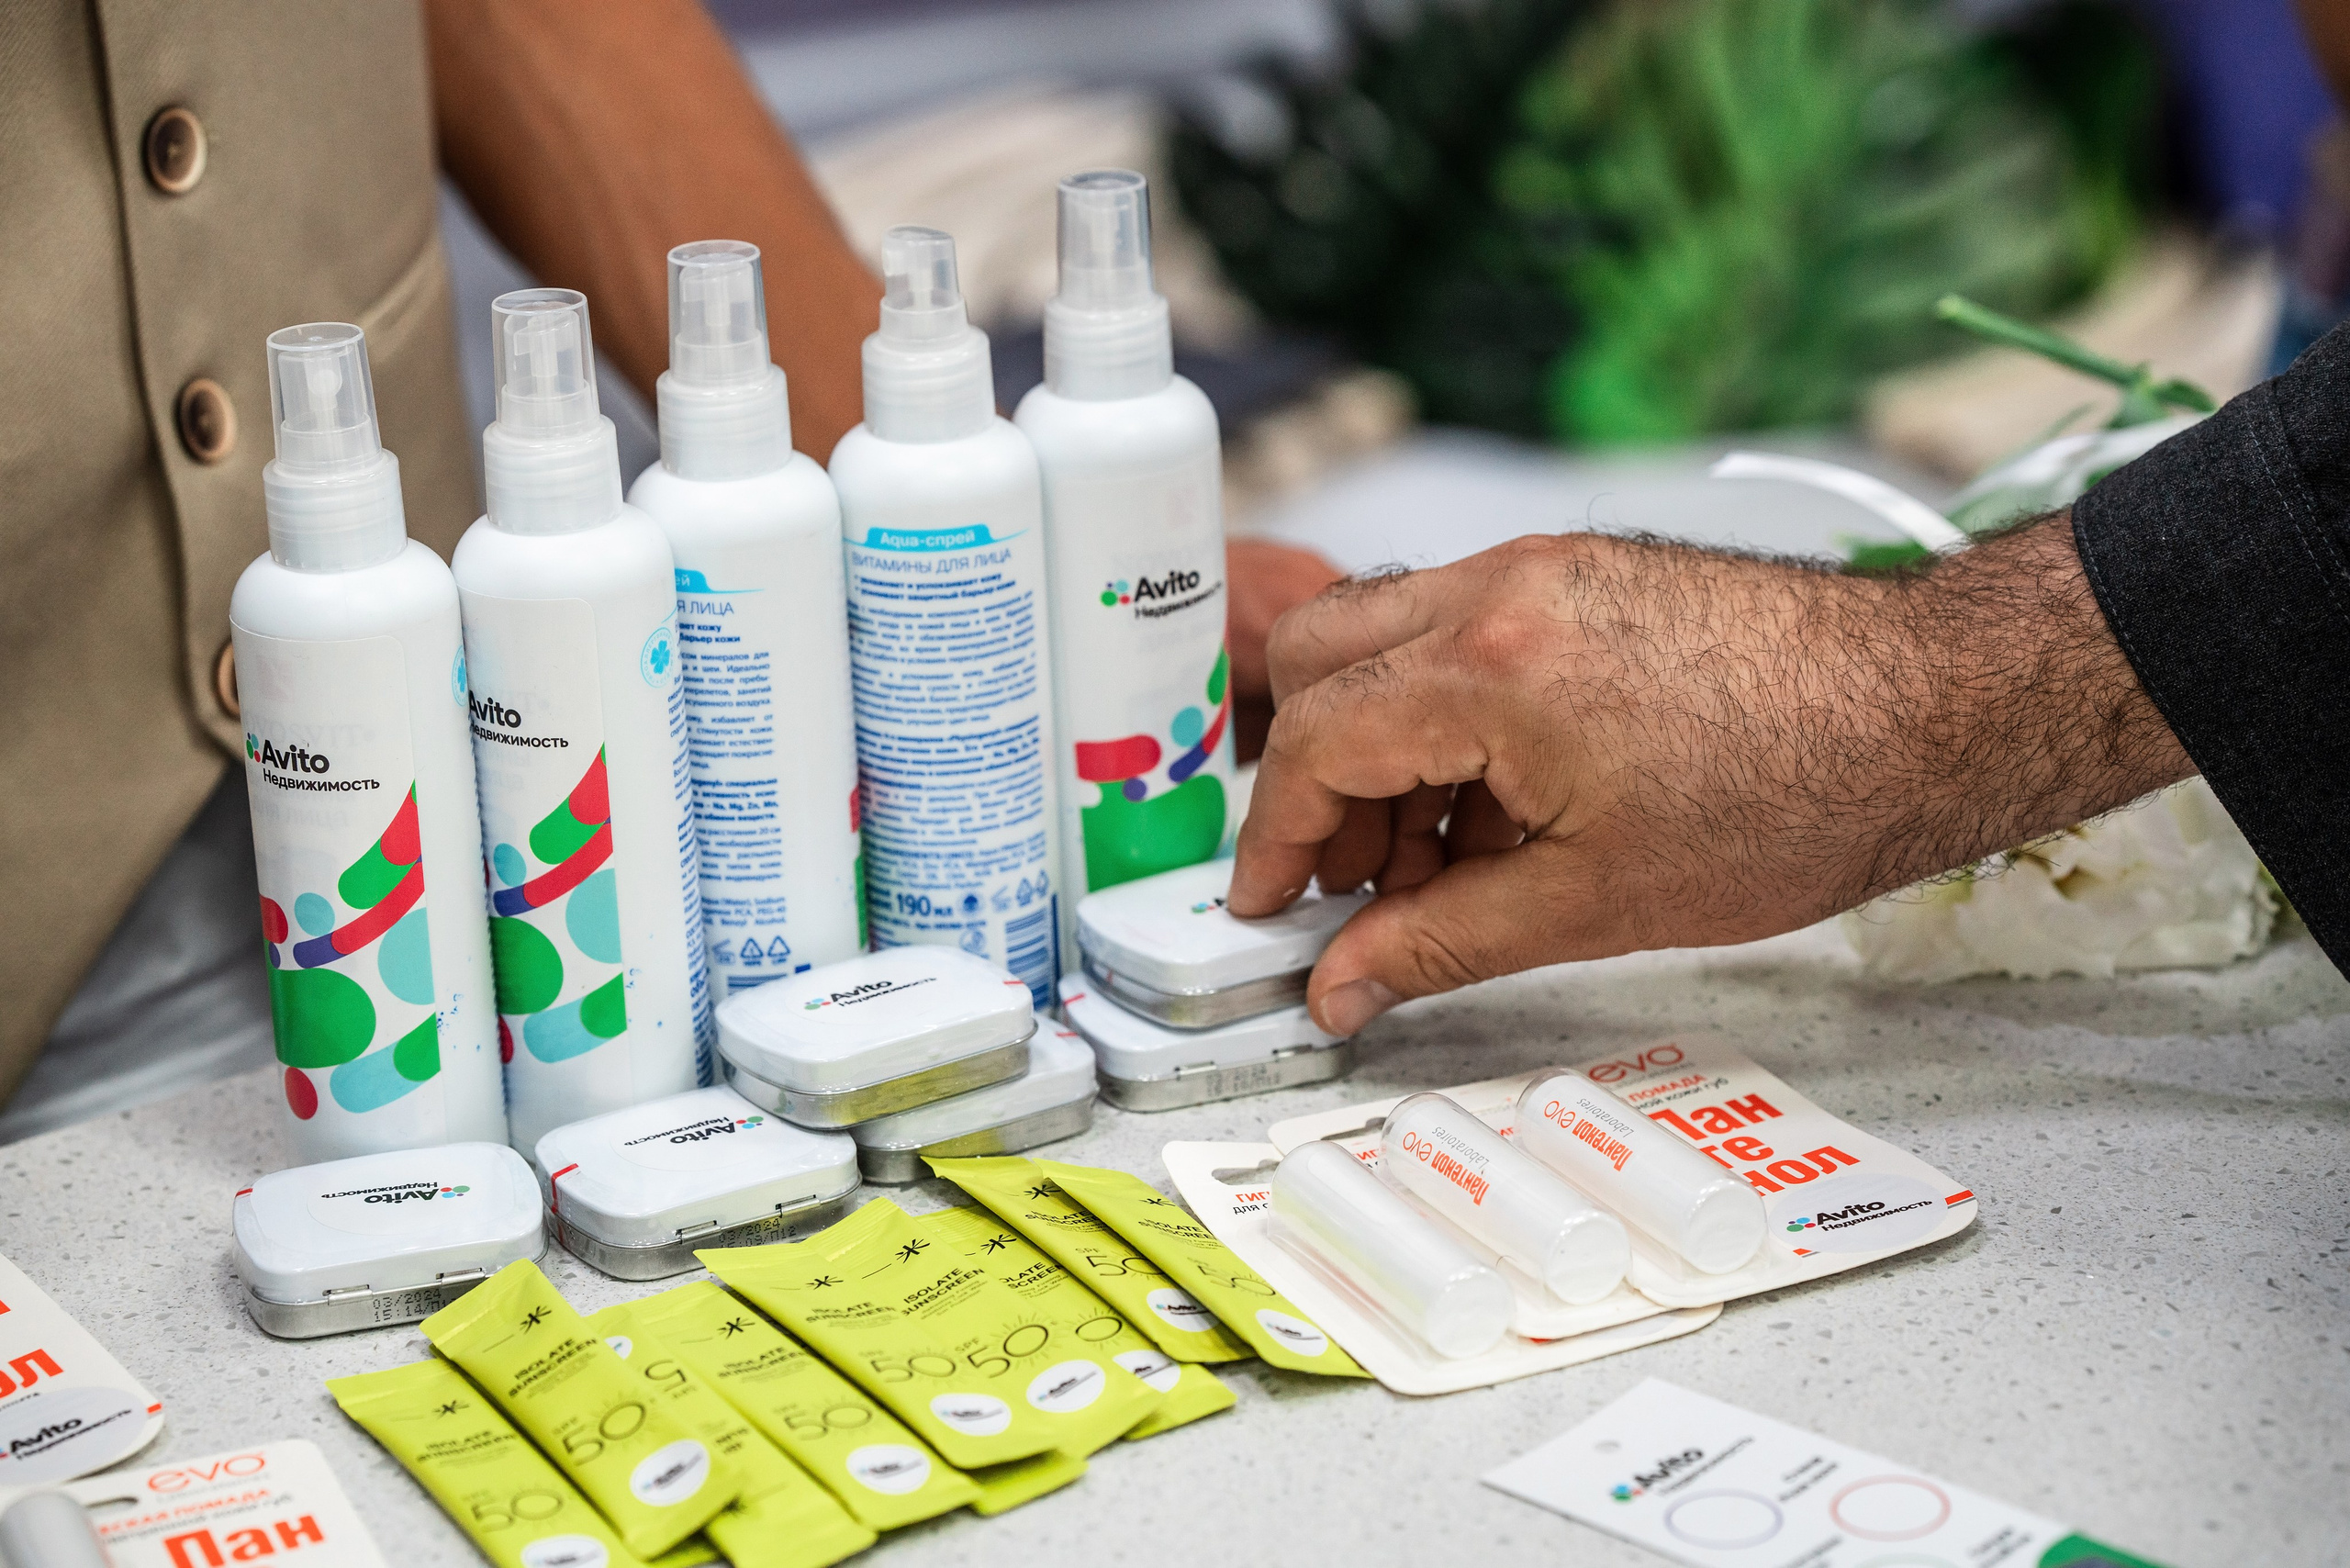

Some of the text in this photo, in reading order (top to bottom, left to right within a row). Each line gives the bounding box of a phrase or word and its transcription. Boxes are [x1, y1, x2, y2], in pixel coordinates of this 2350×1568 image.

[880, 530, 976, 549] Aqua-спрей
[852, 548, 1012, 574] ВИТАМИНЫ ДЛЯ ЛИЦА
[1135, 571, 1200, 602] Avito
[689, 601, 734, 617] ЛИЦА
[697, 623, 722, 633] кожу
[469, 690, 522, 728] Avito
[471, 723, 570, 748] едвижимость
[262, 739, 330, 774] Avito
[263, 767, 380, 792] Недвижимость
[897, 894, 932, 916] 190
[831, 980, 893, 1002] Avito
[1588, 1043, 1685, 1083] evo
[1628, 1074, 1708, 1102] ПОМАДА
[1575, 1098, 1635, 1138] Laboratoires
[670, 1122, 736, 1145] Avito
[1431, 1126, 1490, 1170] Laboratoires
[1543, 1100, 1634, 1172] Пантенол evo
[1403, 1131, 1491, 1206] Пантенол evo
[1741, 1146, 1861, 1197] нол
[321, 1182, 438, 1199] Недвижимость
[363, 1188, 440, 1204] Avito
[1233, 1204, 1260, 1215] для
[1817, 1201, 1886, 1226] Avito
[1821, 1199, 1932, 1231] Недвижимость
[999, 1261, 1046, 1283] OLATE
[1086, 1255, 1166, 1277] 50
[373, 1289, 442, 1310] 03/2024
[901, 1268, 986, 1317] SUNSCREEN
[903, 1268, 964, 1304] ISOLATE
[812, 1301, 875, 1314] ISOLATE
[514, 1338, 576, 1380] ISOLATE
[955, 1338, 980, 1354] SPF
[967, 1325, 1048, 1379] 50
[871, 1354, 957, 1384] 50
[10, 1418, 84, 1453] Avito
[562, 1399, 647, 1466] 50
[783, 1402, 873, 1441] 50
[147, 1452, 266, 1495] evo
[471, 1488, 564, 1533] 50
[162, 1515, 325, 1568] Пан
